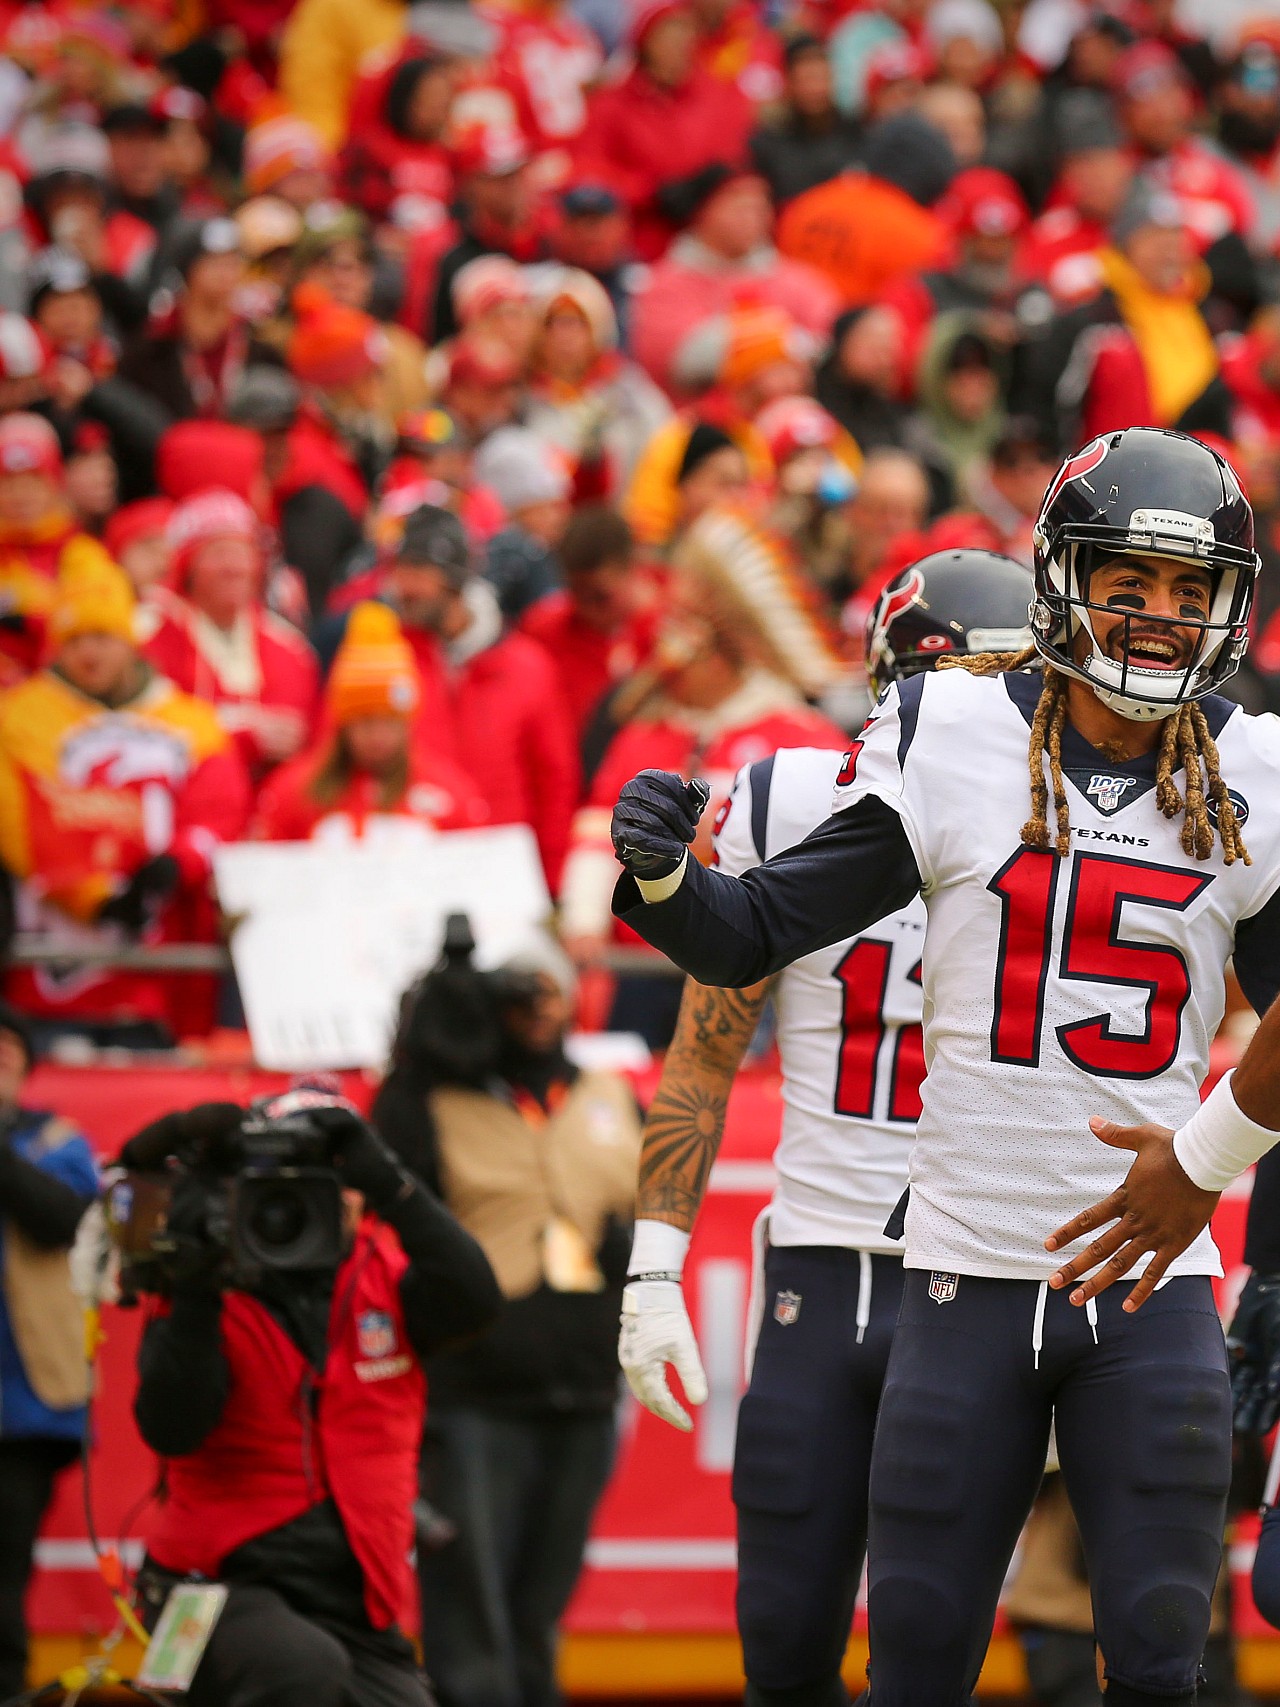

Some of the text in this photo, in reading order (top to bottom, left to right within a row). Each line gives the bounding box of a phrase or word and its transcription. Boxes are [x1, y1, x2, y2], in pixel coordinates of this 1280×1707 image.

[1152, 516, 1194, 528] TEXANS
[1101, 797, 1116, 808] NFL
[986, 844, 1217, 1080] 15
[933, 1281, 952, 1297] NFL
